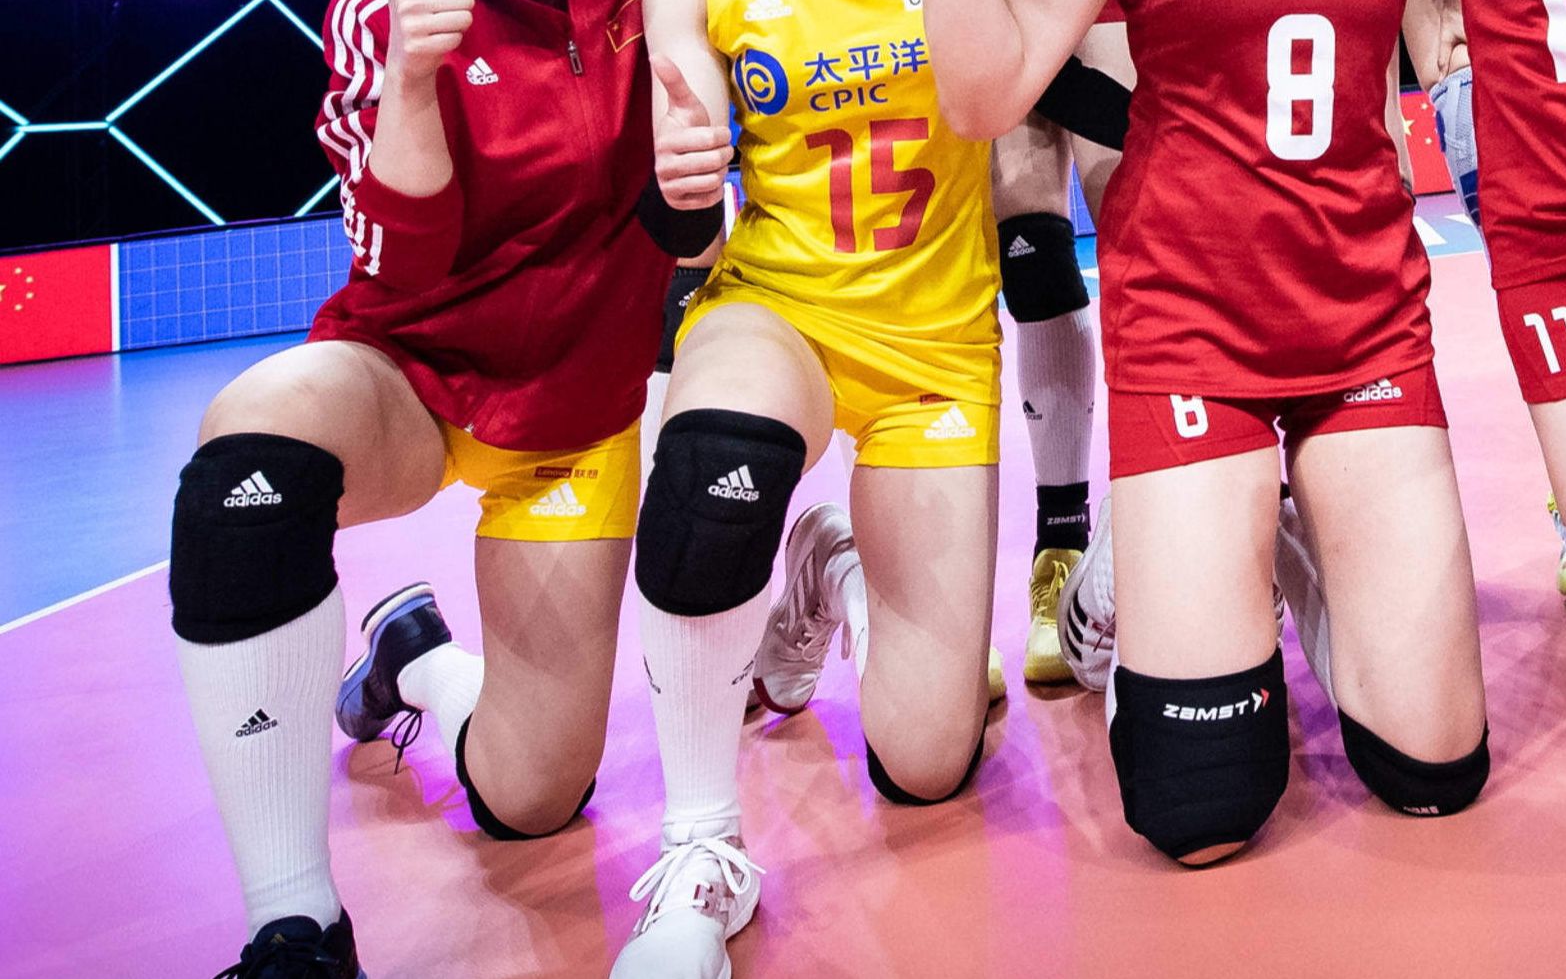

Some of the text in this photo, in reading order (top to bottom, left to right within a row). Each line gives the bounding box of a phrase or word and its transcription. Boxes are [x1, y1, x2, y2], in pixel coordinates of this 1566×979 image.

[1266, 13, 1336, 161] 8
[809, 83, 889, 112] CPIC
[804, 116, 936, 254] 15
[1007, 245, 1036, 258] adidas
[1343, 385, 1403, 403] adidas
[223, 491, 283, 507] adidas
[708, 482, 760, 503] adidas
[235, 718, 279, 738] adidas
